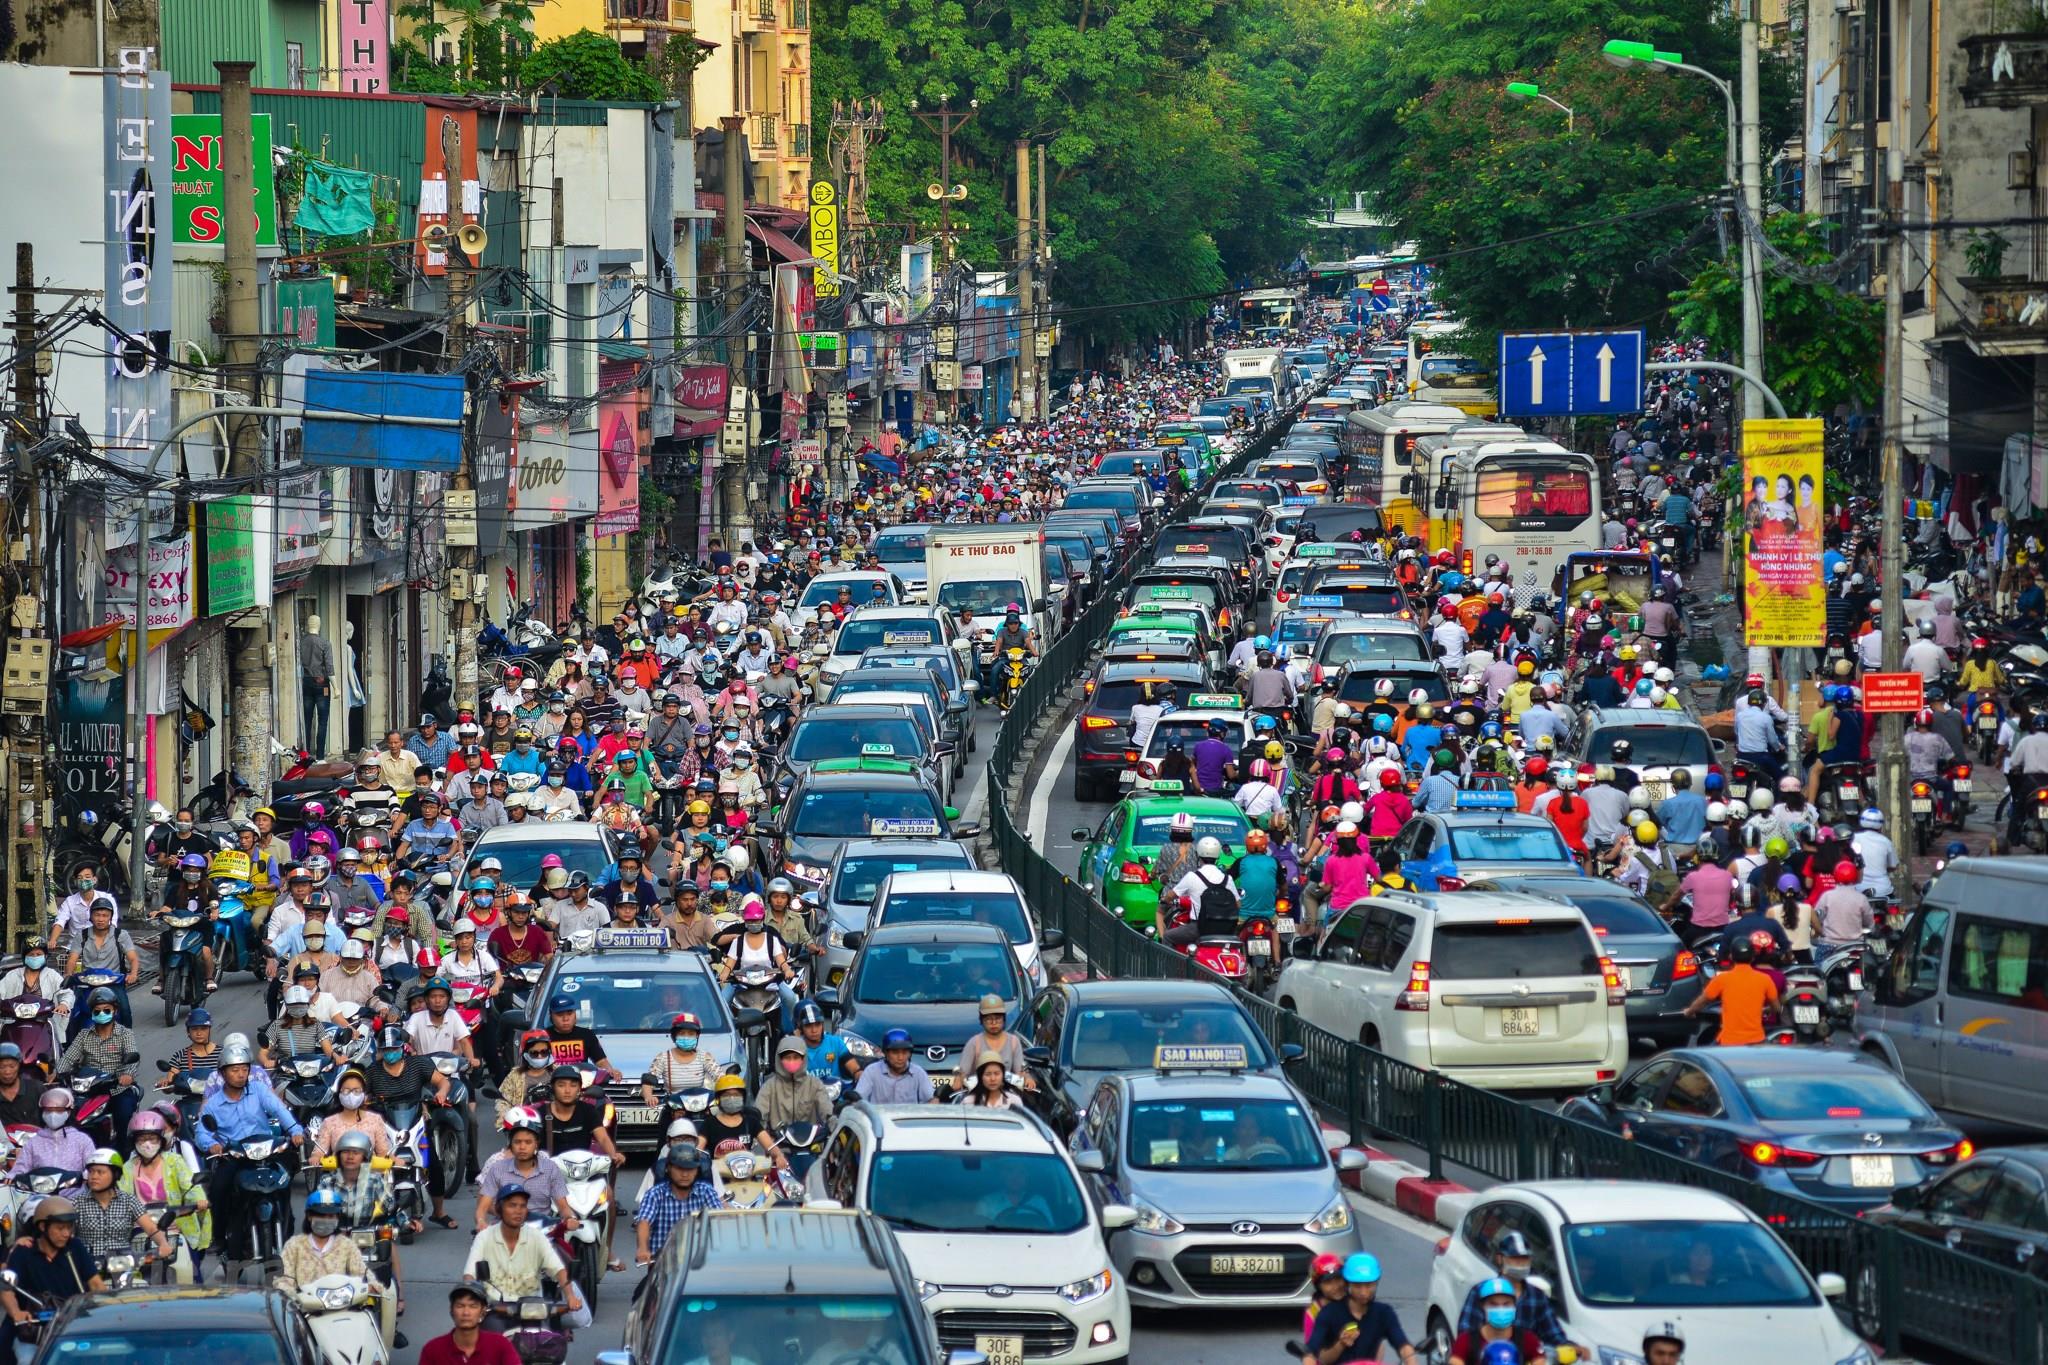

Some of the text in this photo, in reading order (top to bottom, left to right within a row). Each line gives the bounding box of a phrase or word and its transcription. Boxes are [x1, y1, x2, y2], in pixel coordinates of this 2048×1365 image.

[950, 547, 964, 556] XE
[967, 545, 990, 556] THƯ
[79, 722, 121, 752] WINTER
[613, 935, 631, 947] SAO
[555, 1044, 582, 1059] 1916
[1164, 1048, 1186, 1062] SAO
[1214, 1258, 1281, 1273] 30A-382.01
[986, 1339, 1012, 1354] 30E
